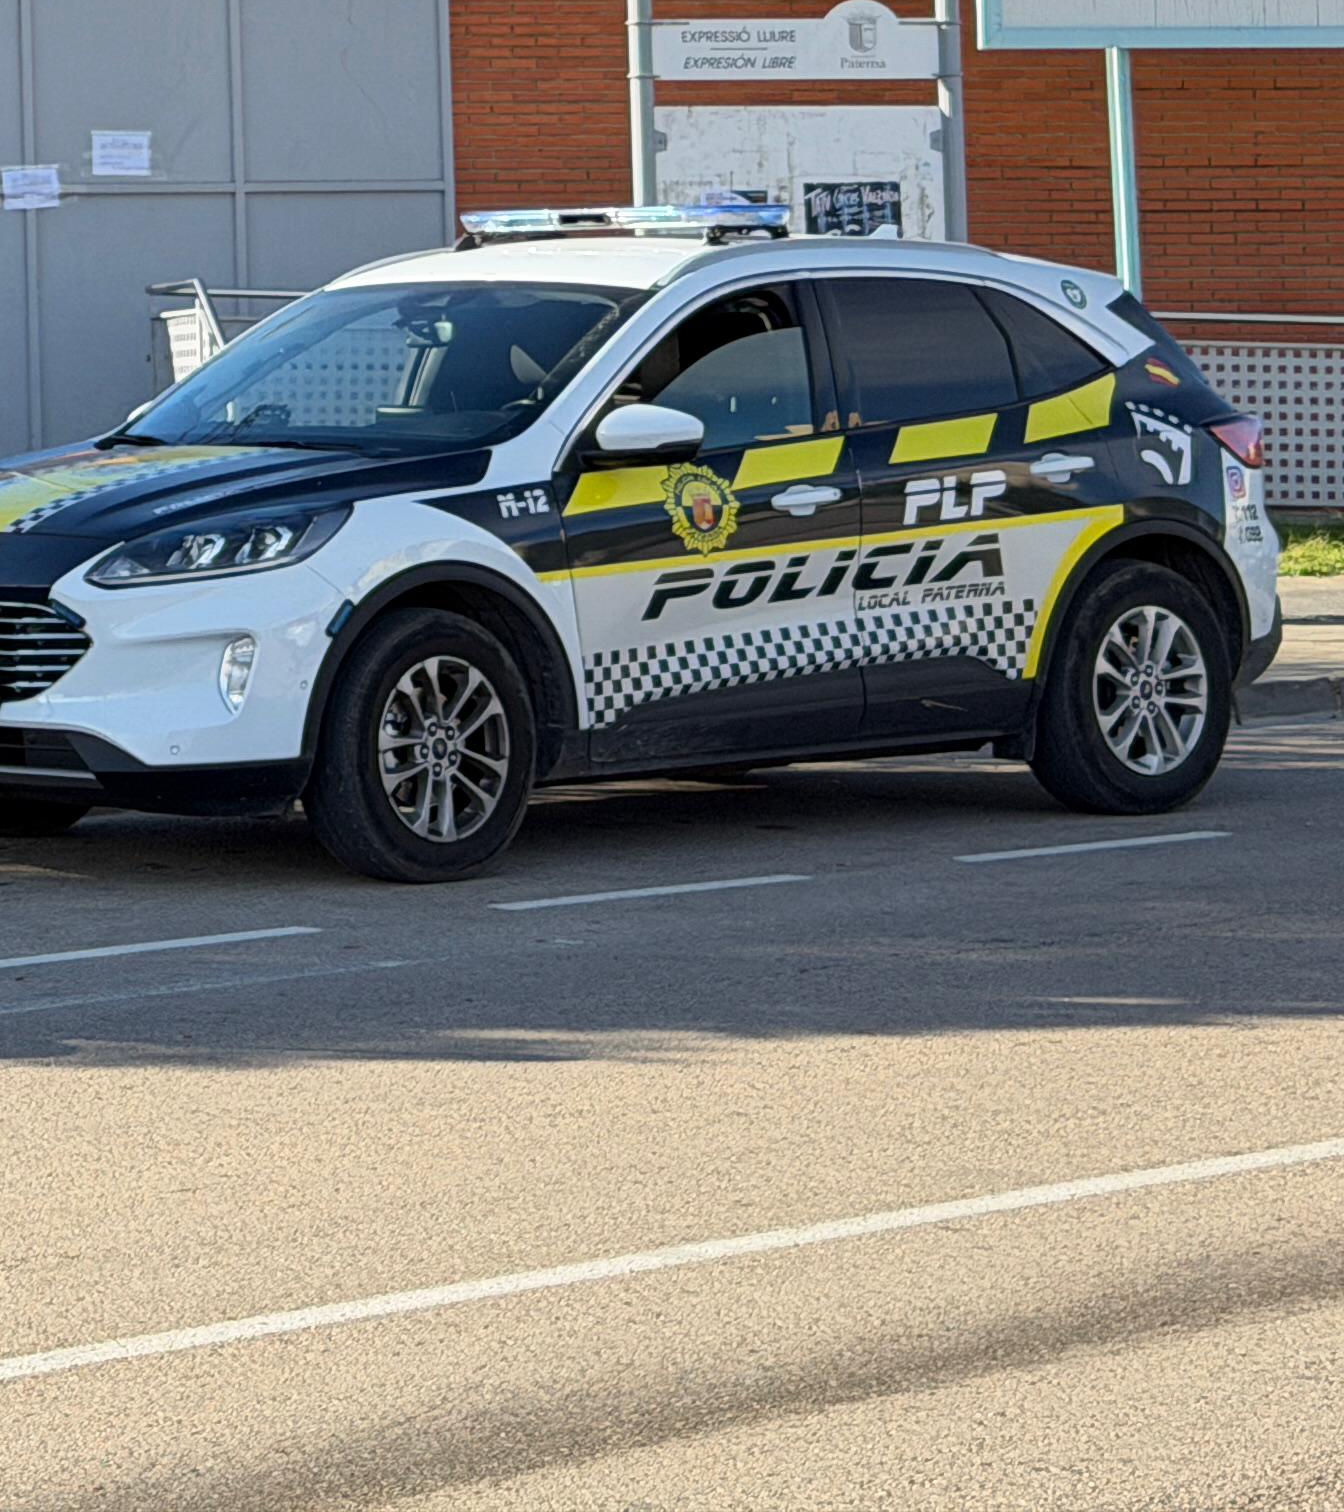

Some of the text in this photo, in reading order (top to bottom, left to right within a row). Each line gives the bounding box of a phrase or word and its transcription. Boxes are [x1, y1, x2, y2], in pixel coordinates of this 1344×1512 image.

[681, 26, 750, 43] EXPRESSIÓ
[683, 53, 797, 69] EXPRESIÓN LIBRE
[903, 470, 1007, 526] PLP
[857, 581, 1006, 612] LOCAL PATERNA
